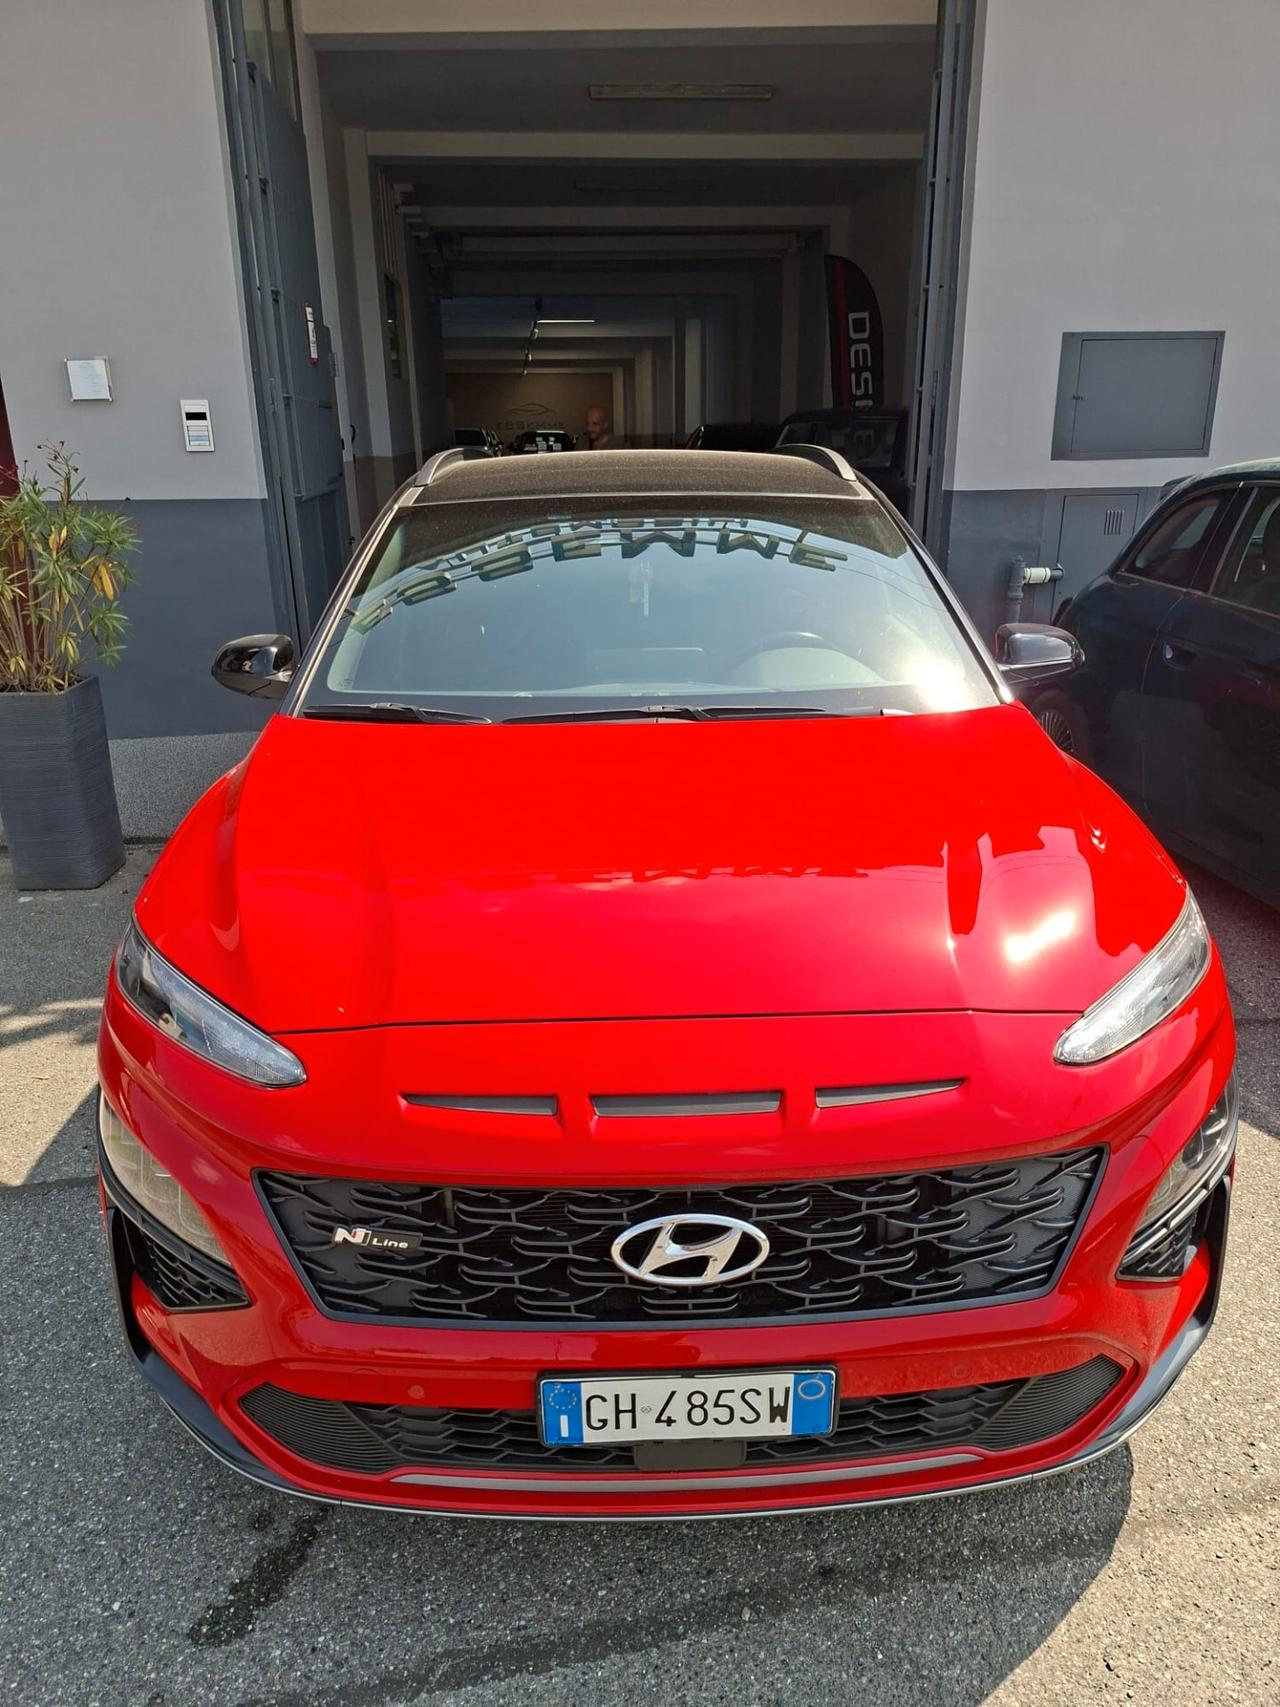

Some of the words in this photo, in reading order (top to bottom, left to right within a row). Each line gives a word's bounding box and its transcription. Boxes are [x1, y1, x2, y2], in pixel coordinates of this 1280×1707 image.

[372, 1238, 408, 1249] Line
[585, 1393, 637, 1430] GH
[654, 1386, 791, 1427] 485SW
